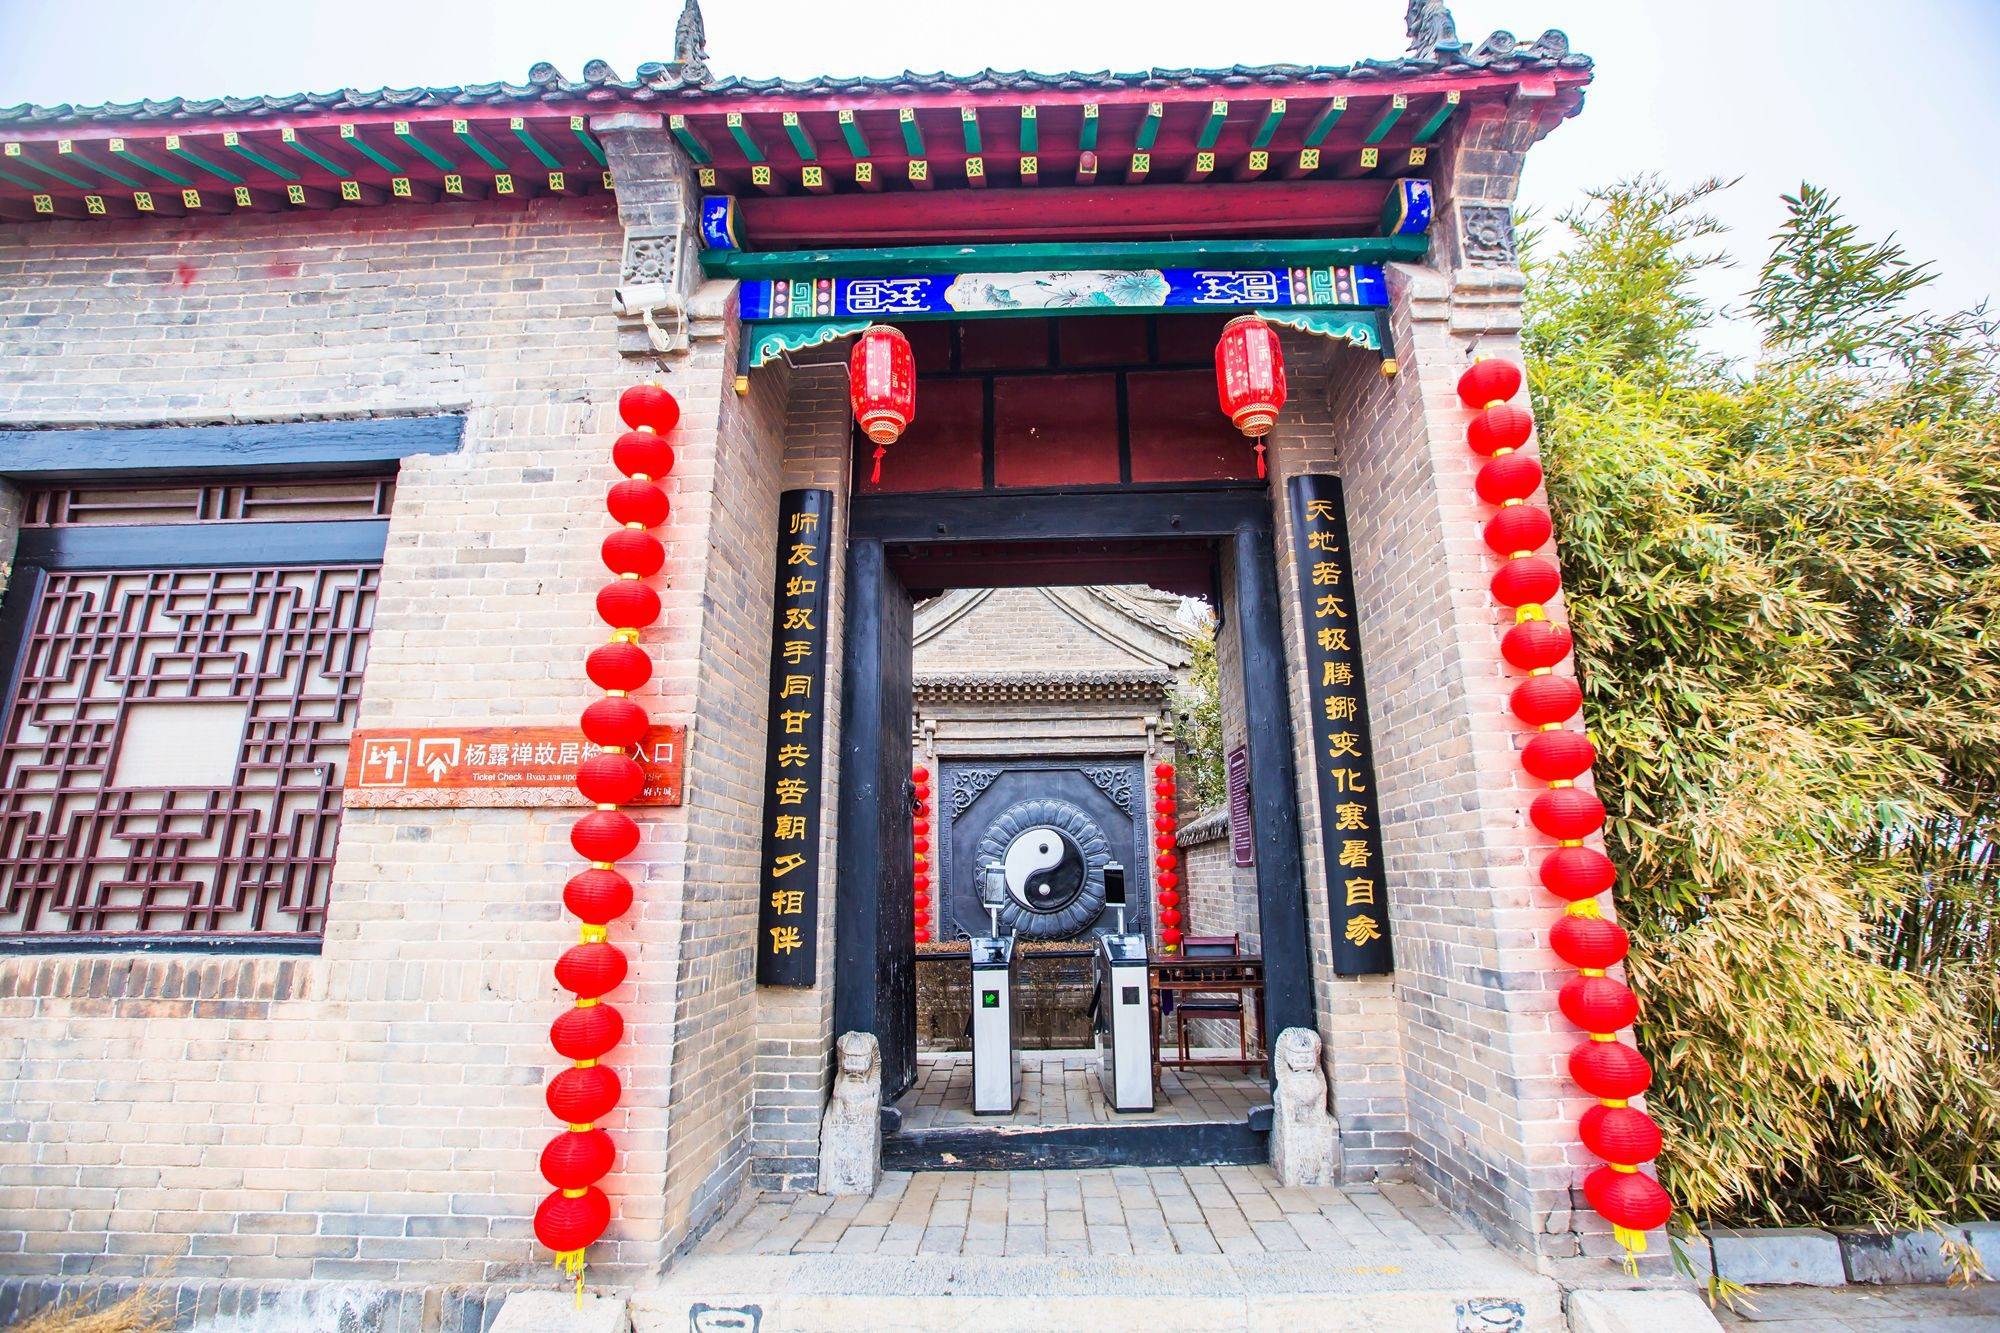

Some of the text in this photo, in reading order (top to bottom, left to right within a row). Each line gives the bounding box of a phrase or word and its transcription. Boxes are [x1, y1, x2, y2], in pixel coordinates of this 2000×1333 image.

[768, 511, 820, 956] 师友如双手同甘共苦朝夕相伴
[1304, 499, 1382, 948] 天地若太极腾挪变化寒暑自参
[463, 741, 674, 767] 杨露禅故居检入口
[472, 772, 522, 781] Ticket Check
[526, 772, 546, 781] Вход
[546, 773, 561, 781] для
